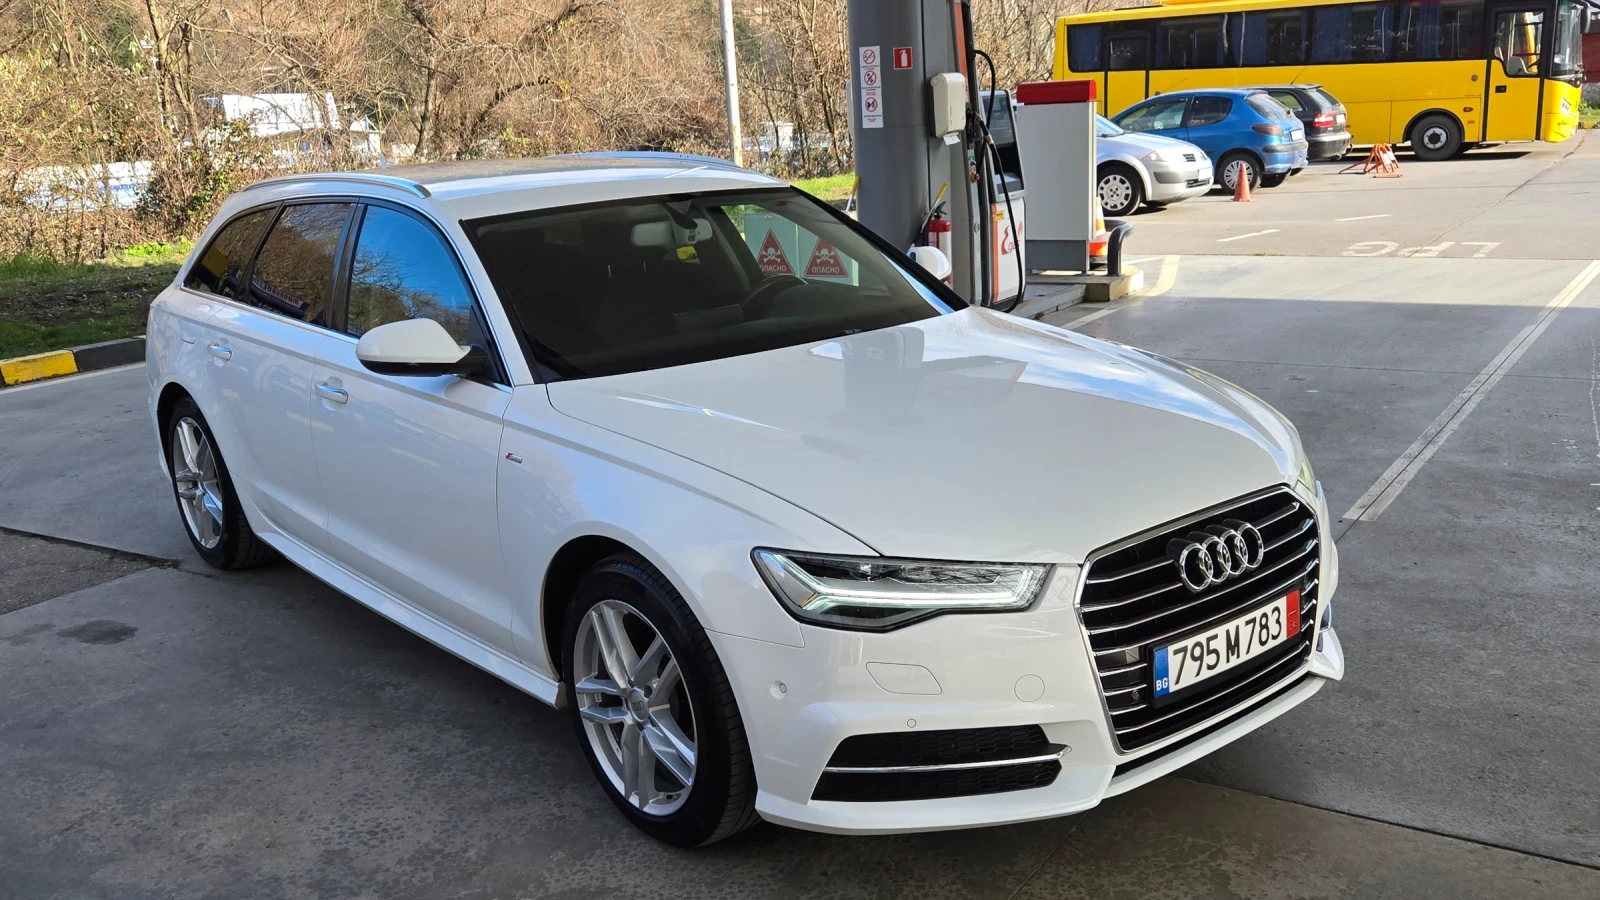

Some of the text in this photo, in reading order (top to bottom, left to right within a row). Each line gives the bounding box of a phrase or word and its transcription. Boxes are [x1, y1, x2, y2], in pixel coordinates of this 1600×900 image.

[1340, 240, 1502, 258] LPG
[811, 266, 840, 274] ОПАСНО
[1156, 677, 1169, 691] BG
